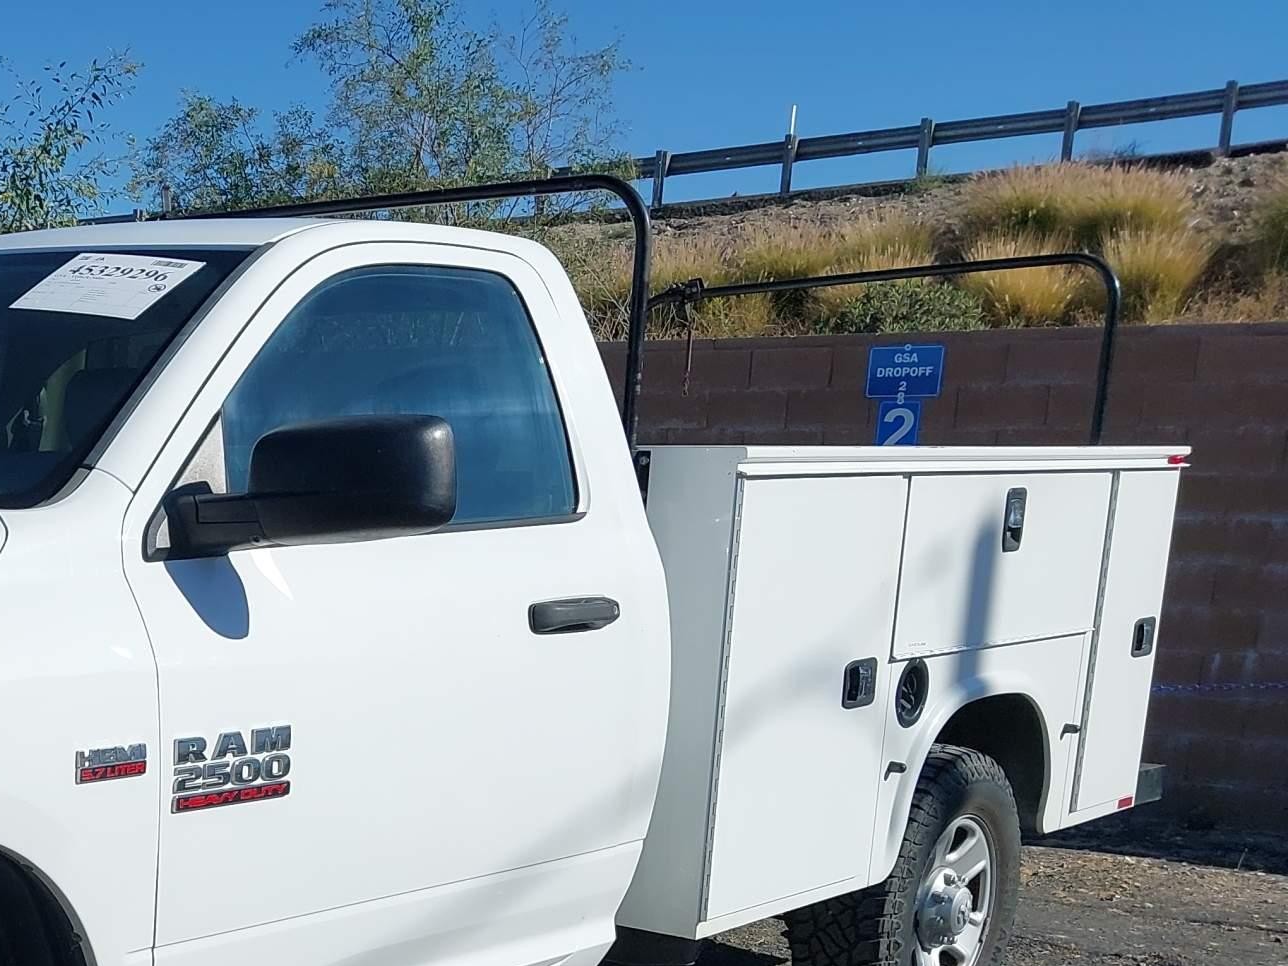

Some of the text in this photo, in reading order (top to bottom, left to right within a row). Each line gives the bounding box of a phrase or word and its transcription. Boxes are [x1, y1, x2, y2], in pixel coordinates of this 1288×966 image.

[68, 264, 174, 282] 45329296
[894, 352, 918, 363] GSA
[876, 366, 934, 378] DROPOFF
[898, 381, 907, 391] 2
[883, 407, 915, 447] 2
[75, 743, 146, 769] HEMI
[173, 724, 292, 766] RAM
[81, 761, 145, 781] 5.7 LITER
[171, 753, 291, 795] 2500
[178, 783, 288, 809] HEAVY DUTY
